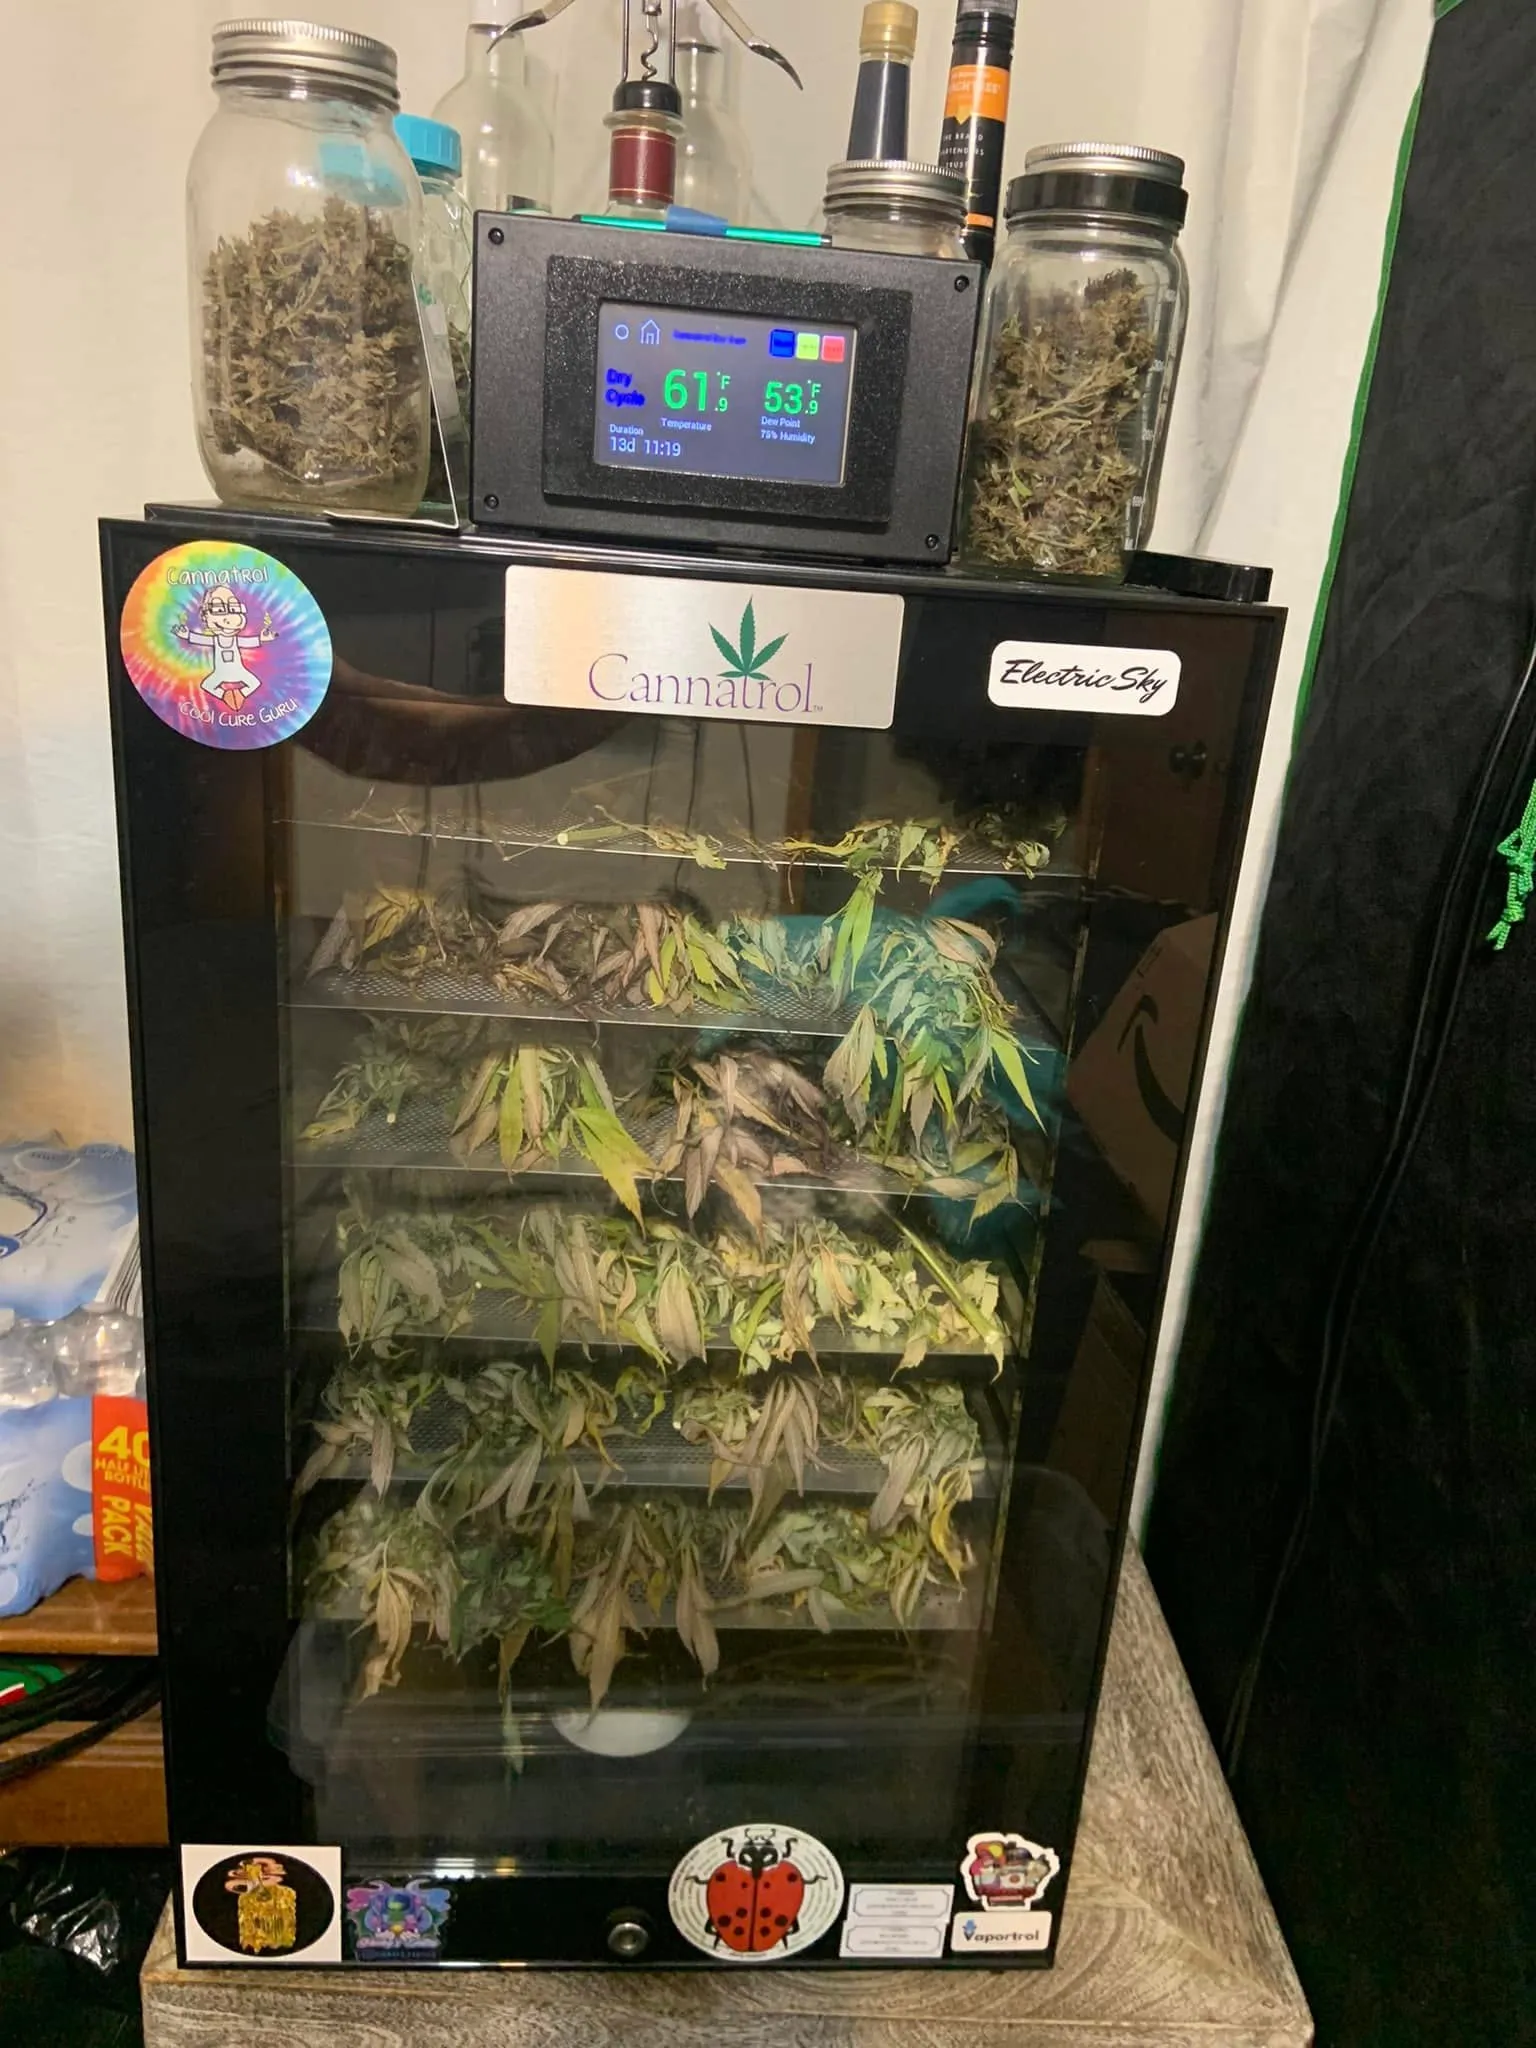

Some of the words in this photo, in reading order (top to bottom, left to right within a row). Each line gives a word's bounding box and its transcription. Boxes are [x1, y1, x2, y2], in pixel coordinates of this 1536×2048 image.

[955, 133, 984, 141] BRAD
[606, 367, 632, 388] Dry
[605, 389, 646, 408] Cycle
[664, 369, 707, 411] 61
[764, 380, 803, 414] 53
[609, 423, 645, 436] Duration
[661, 416, 712, 432] Temperature
[761, 416, 778, 426] Dew
[779, 417, 801, 428] Point
[610, 436, 636, 453] 13d
[643, 440, 681, 457] 11:19
[780, 431, 816, 445] Humidity
[588, 652, 814, 713] Cannatrol
[1000, 659, 1116, 688] Electric
[1110, 666, 1169, 703] Sky
[95, 1457, 130, 1473] HALF
[101, 1494, 133, 1558] PACK
